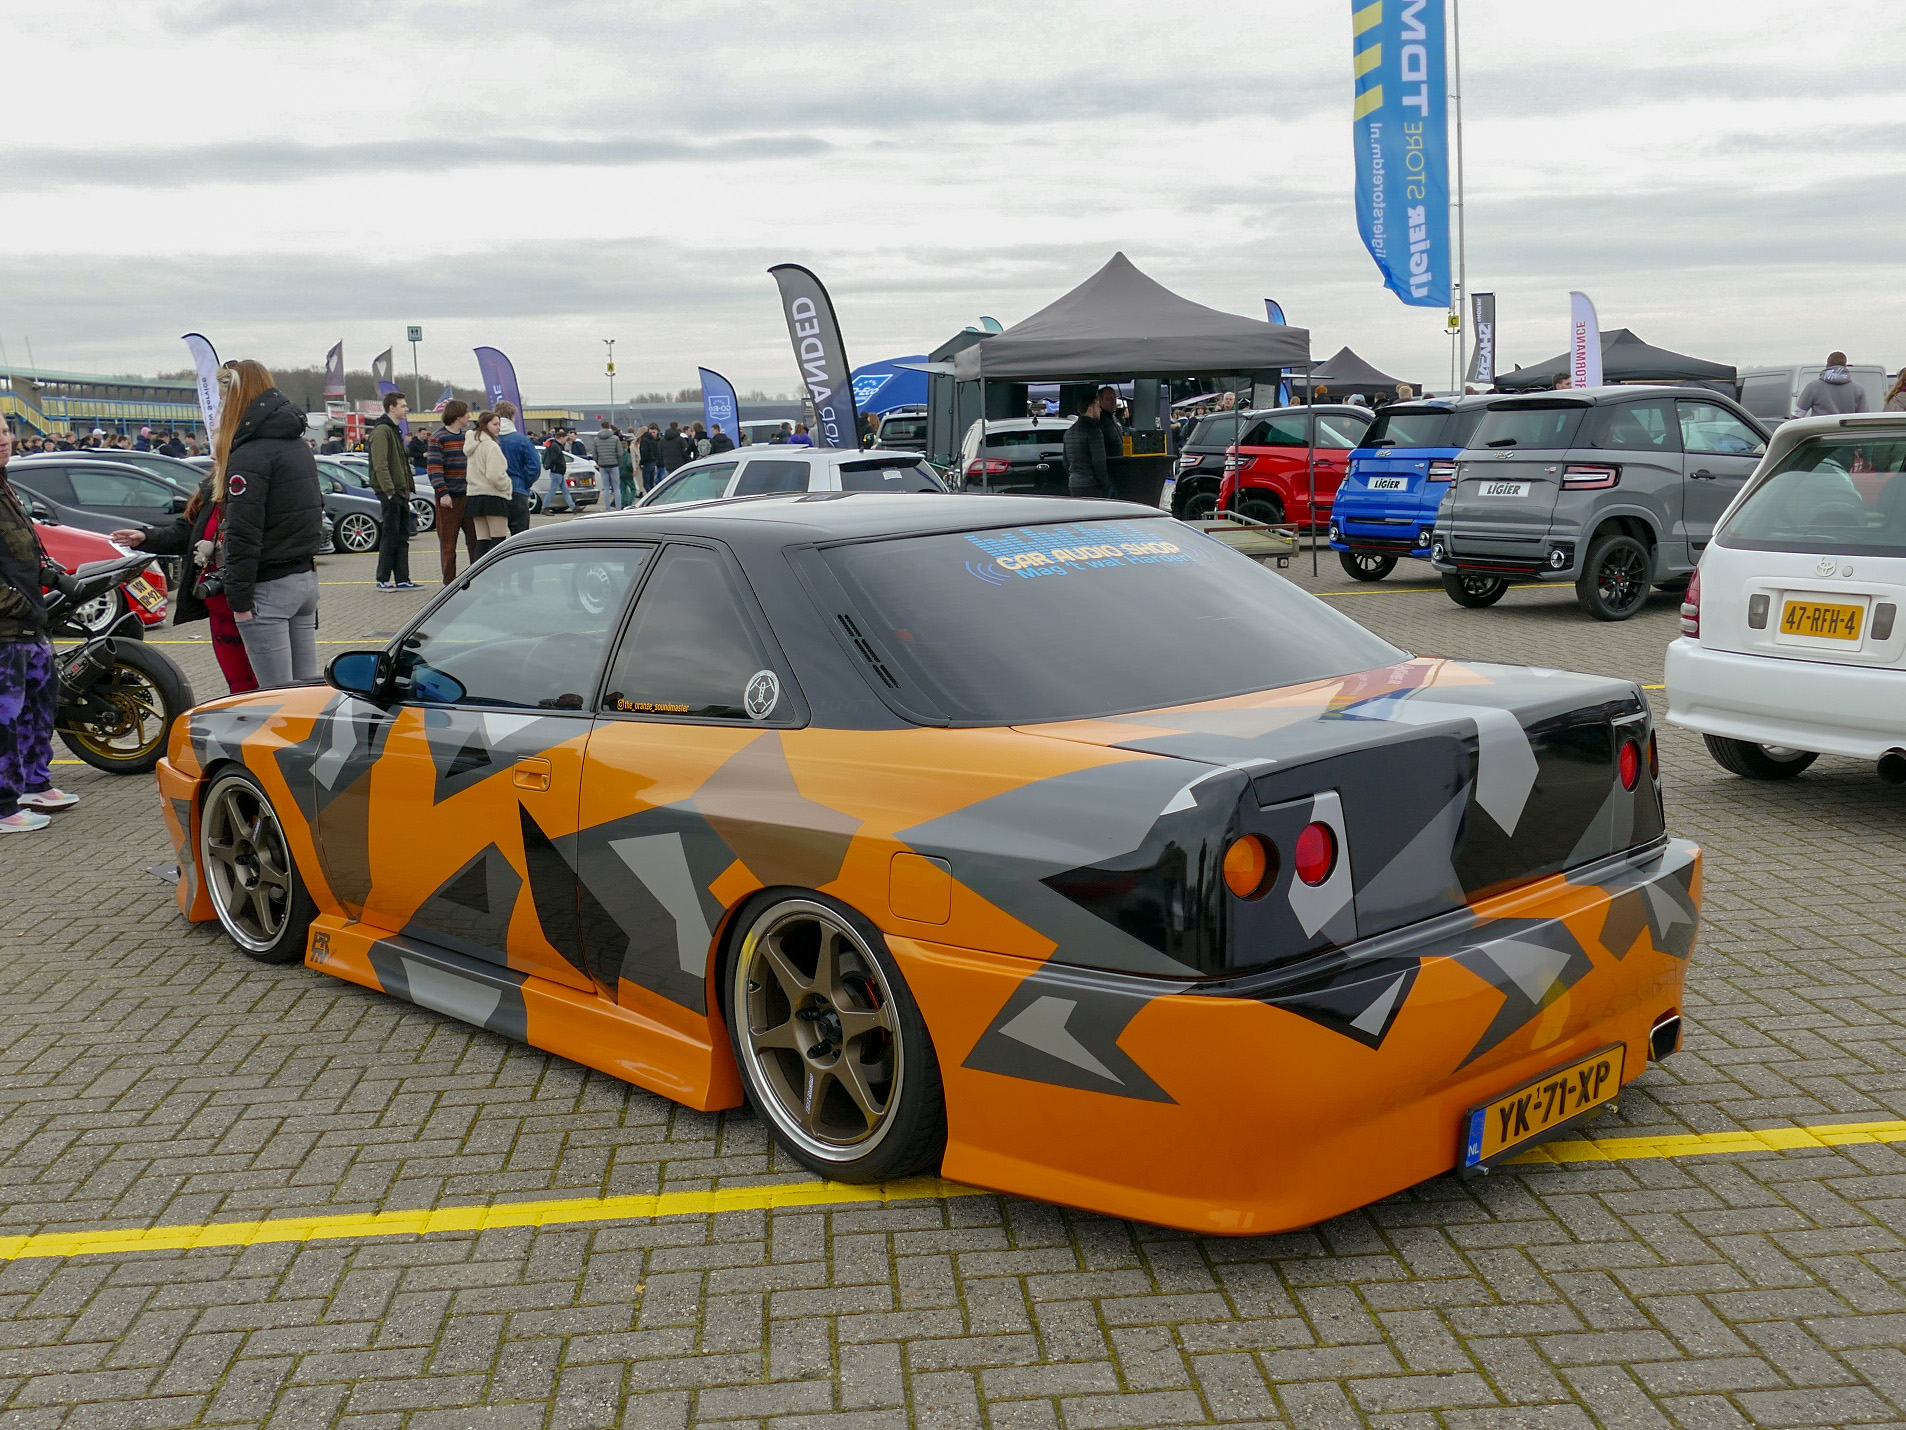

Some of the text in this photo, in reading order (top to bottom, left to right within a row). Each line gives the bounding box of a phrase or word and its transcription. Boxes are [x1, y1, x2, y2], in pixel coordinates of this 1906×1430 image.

[1451, 318, 1458, 326] C
[996, 542, 1180, 570] CAR AUDIO SHOP
[1015, 566, 1068, 578] Mag
[1085, 558, 1126, 568] wat
[1786, 606, 1856, 634] 47-RFH-4
[1500, 1060, 1611, 1142] YK-71-XP
[1468, 1144, 1480, 1158] NL
